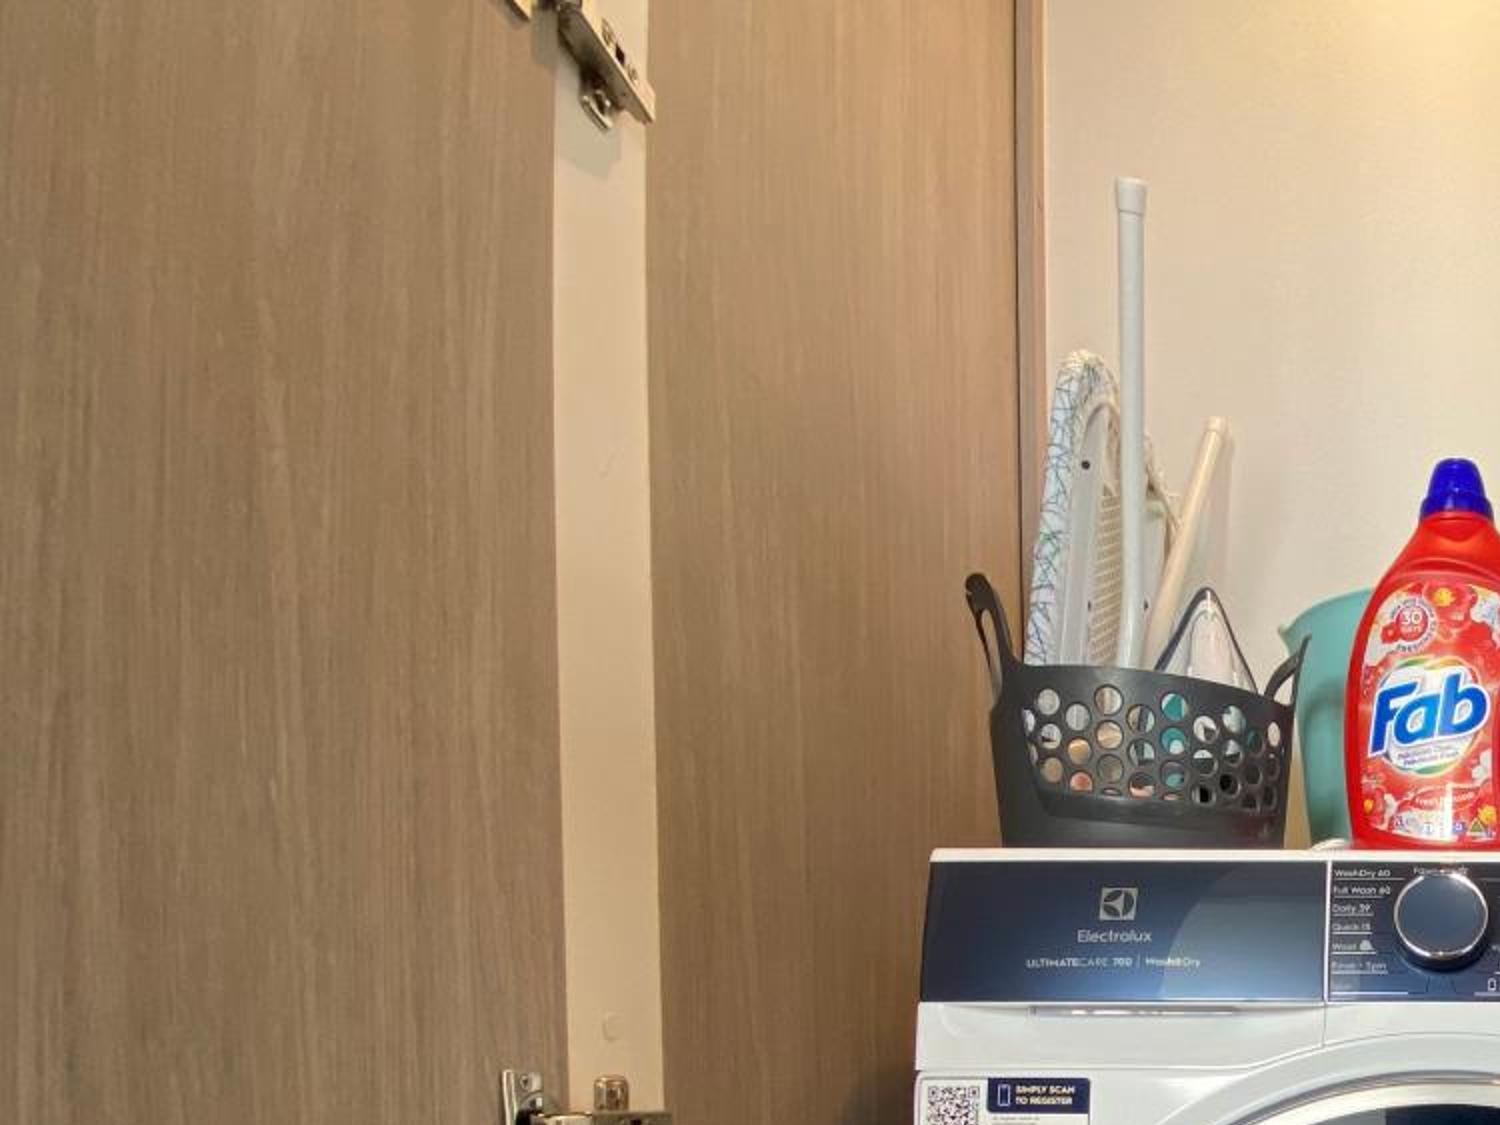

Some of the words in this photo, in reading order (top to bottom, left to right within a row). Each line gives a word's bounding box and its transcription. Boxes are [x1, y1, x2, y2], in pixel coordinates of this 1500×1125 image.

[1368, 671, 1489, 755] Fab
[1076, 929, 1153, 944] Electrolux
[1014, 1085, 1047, 1095] SIMPLY
[1049, 1084, 1076, 1095] SCAN
[1015, 1096, 1029, 1106] TO
[1029, 1096, 1074, 1106] REGISTER
